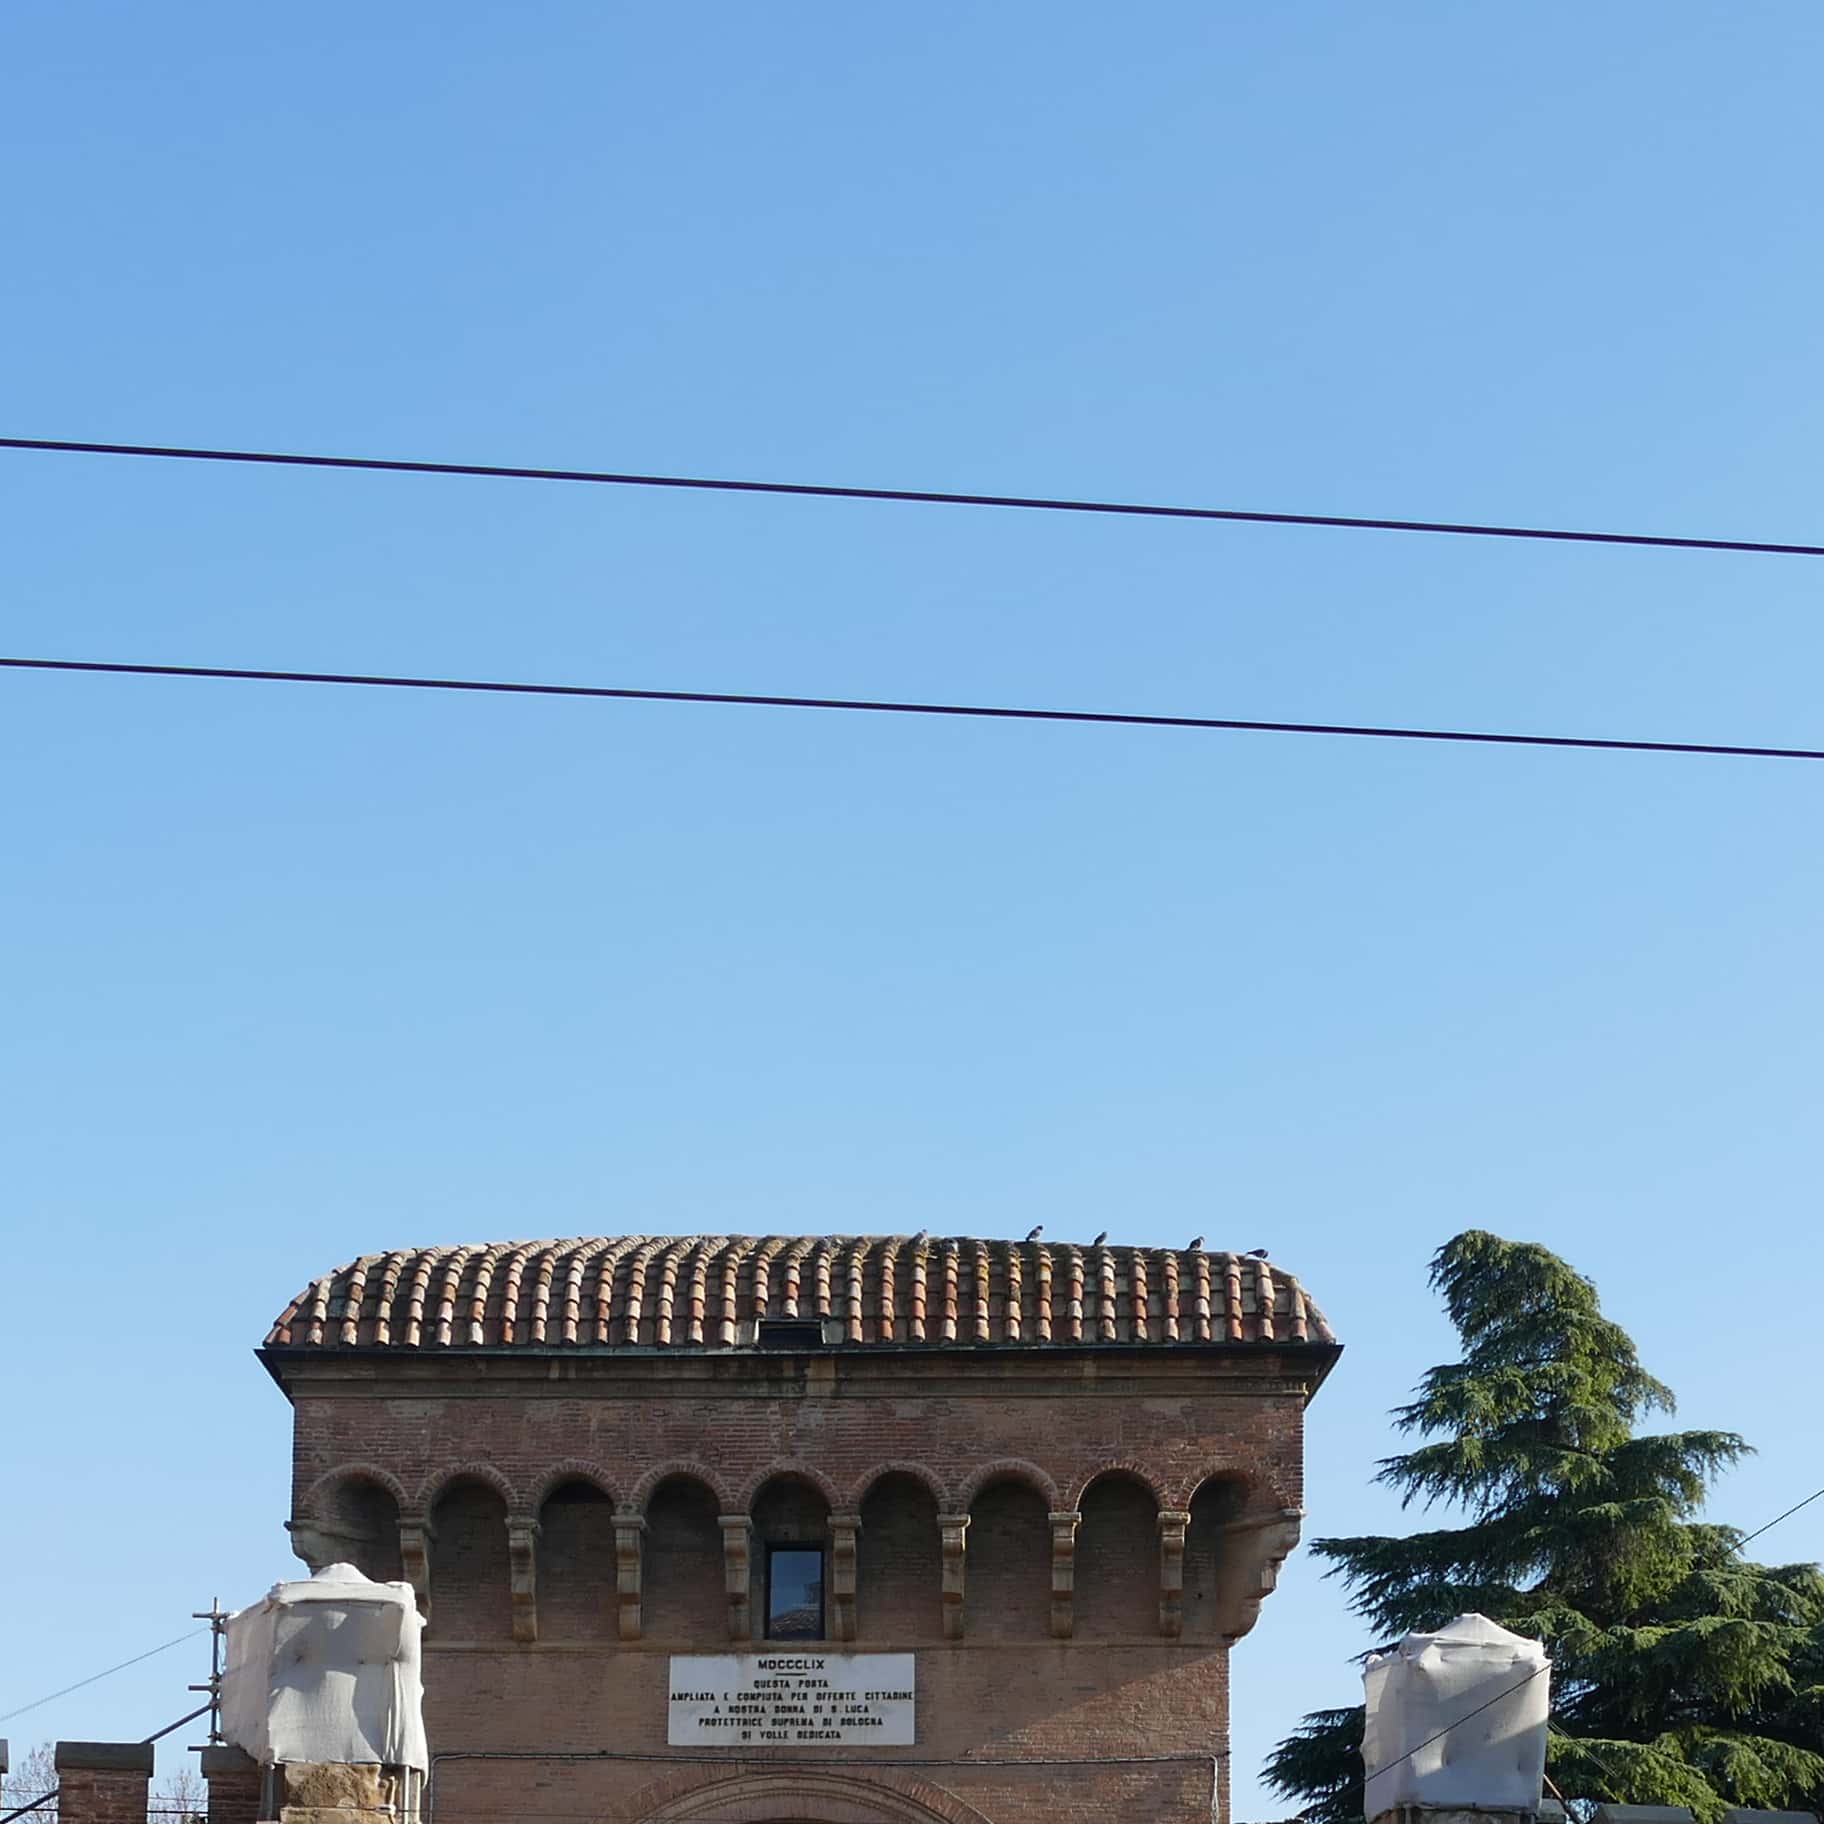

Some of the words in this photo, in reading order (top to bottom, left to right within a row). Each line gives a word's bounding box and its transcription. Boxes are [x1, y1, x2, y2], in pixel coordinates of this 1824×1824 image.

[758, 1659, 825, 1670] MDCCCLIX
[753, 1679, 791, 1688] QUESTA
[798, 1679, 829, 1688] PORTA
[671, 1692, 716, 1701] AMPLIATA
[737, 1692, 783, 1701] COMPIUTA
[791, 1692, 808, 1701] PER
[816, 1691, 857, 1701] OFFERTE
[864, 1691, 913, 1701] CITTADINE
[714, 1705, 721, 1714] A
[728, 1705, 767, 1714] NOSTRA
[774, 1705, 806, 1714] DONNA
[813, 1704, 823, 1714] DI
[698, 1717, 764, 1727] PROTETTRICE
[822, 1717, 833, 1727] DI
[840, 1717, 884, 1727] BOLOGNA
[759, 1730, 789, 1740] VOLLE
[796, 1730, 842, 1740] DEDICATA
